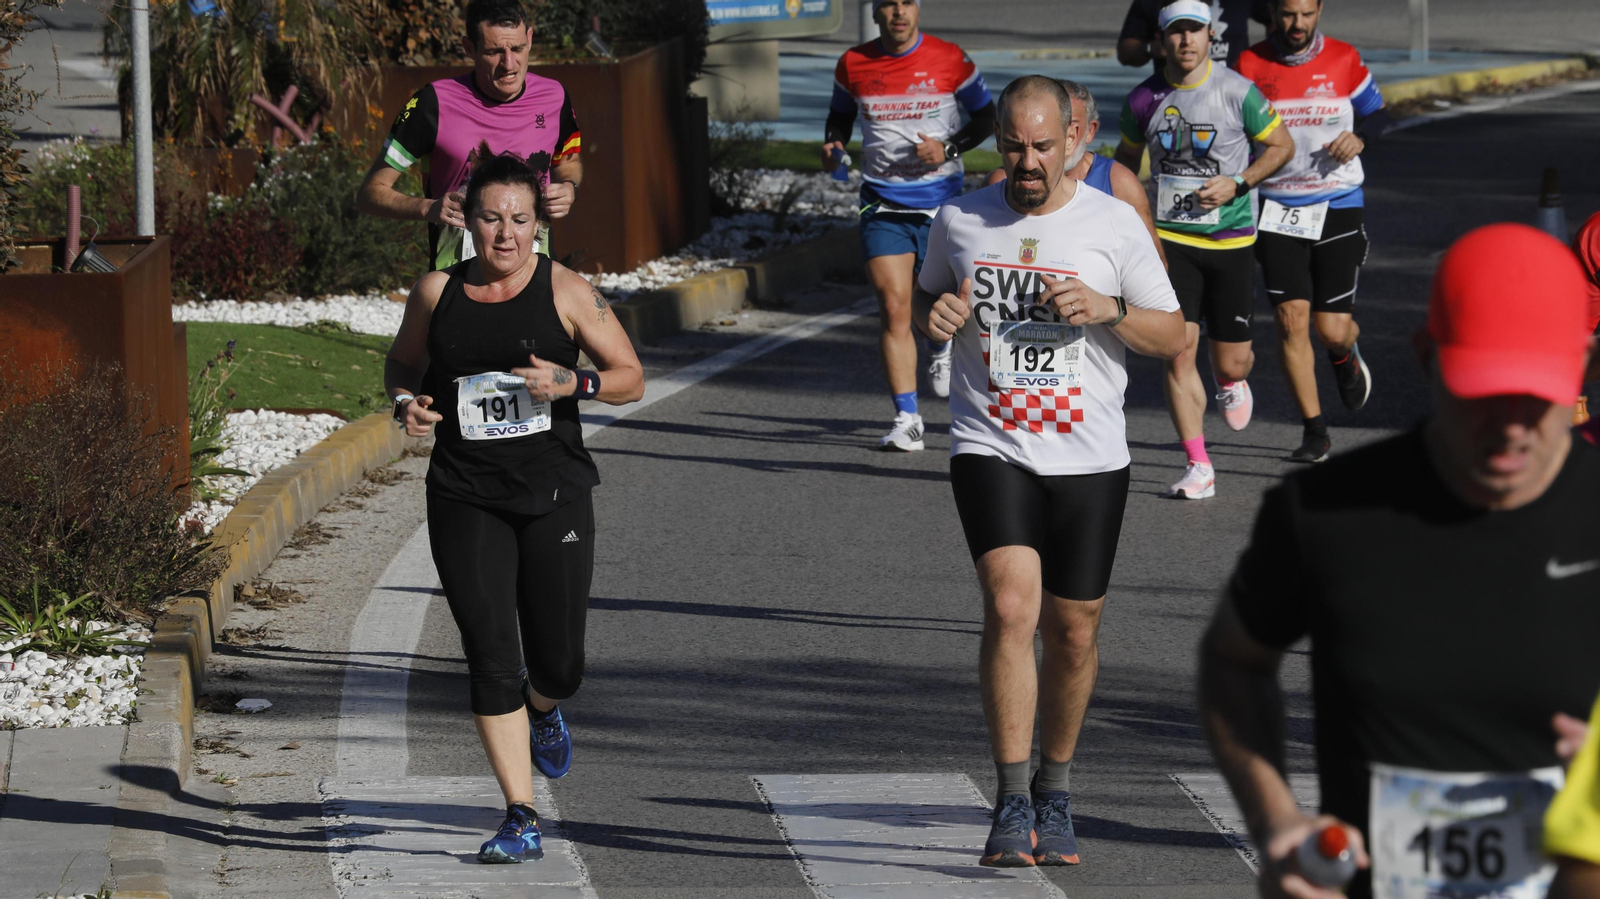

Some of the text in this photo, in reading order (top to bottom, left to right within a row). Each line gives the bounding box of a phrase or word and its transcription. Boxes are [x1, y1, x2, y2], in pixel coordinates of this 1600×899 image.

[871, 102, 913, 112] RUNNING
[916, 100, 940, 110] TEAM
[1315, 106, 1340, 115] TEAM
[876, 112, 923, 122] ALGECIRAS
[1173, 193, 1193, 212] 95
[1281, 207, 1300, 225] 75
[1276, 226, 1304, 236] EVOS
[973, 267, 1077, 304] SWI
[1010, 345, 1055, 372] 192
[1013, 377, 1059, 386] EVOS
[477, 394, 519, 423] 191
[484, 424, 529, 436] EVOS
[1407, 826, 1506, 880] 156
